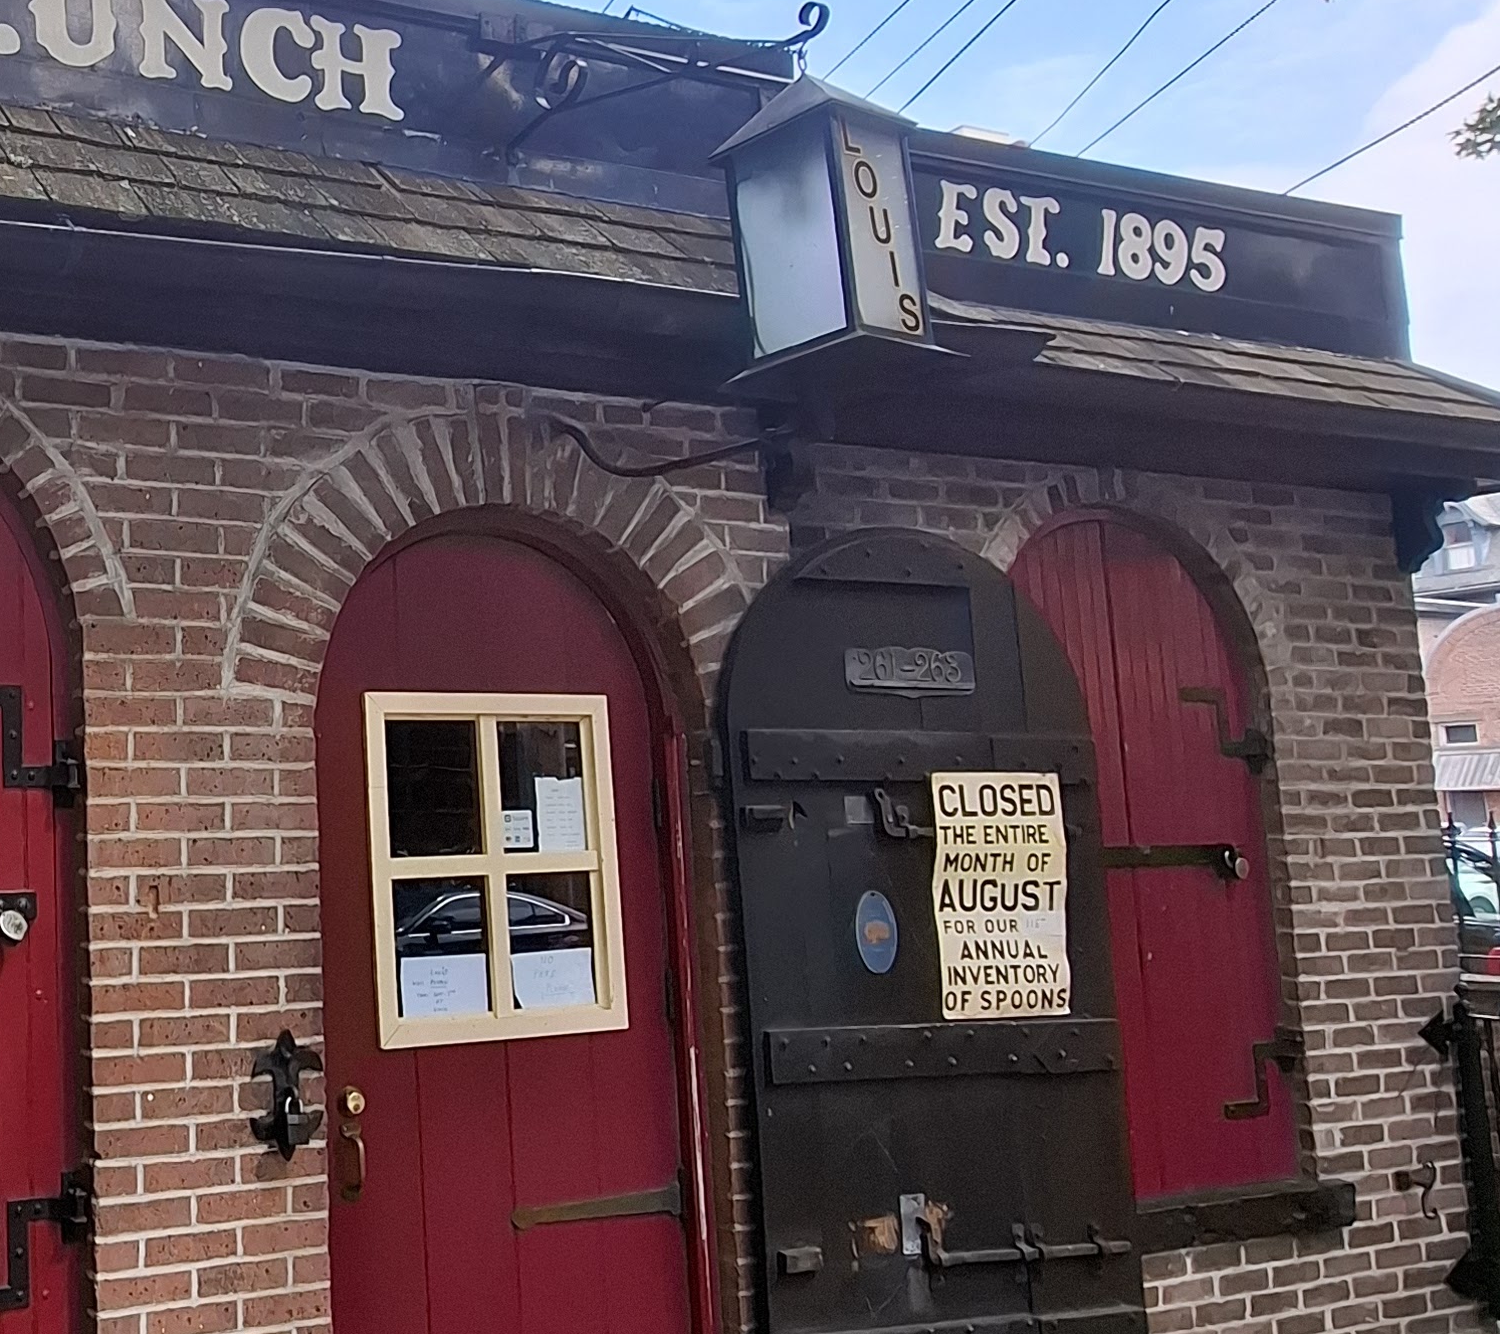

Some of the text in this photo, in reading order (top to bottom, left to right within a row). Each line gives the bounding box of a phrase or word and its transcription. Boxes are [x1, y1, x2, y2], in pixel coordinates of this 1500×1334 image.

[840, 119, 921, 333] LOUIS
[934, 178, 1227, 293] EST. 1895
[938, 783, 1055, 817] CLOSED
[939, 824, 1049, 845] THE ENTIRE
[943, 852, 1051, 873] MONTH OF
[938, 878, 1061, 913] AUGUST
[943, 919, 976, 934] FOR
[984, 918, 1019, 934] OUR
[960, 939, 1048, 960] ANNUAL
[947, 963, 1060, 986] INVENTORY
[945, 988, 1067, 1011] OF SPOONS
